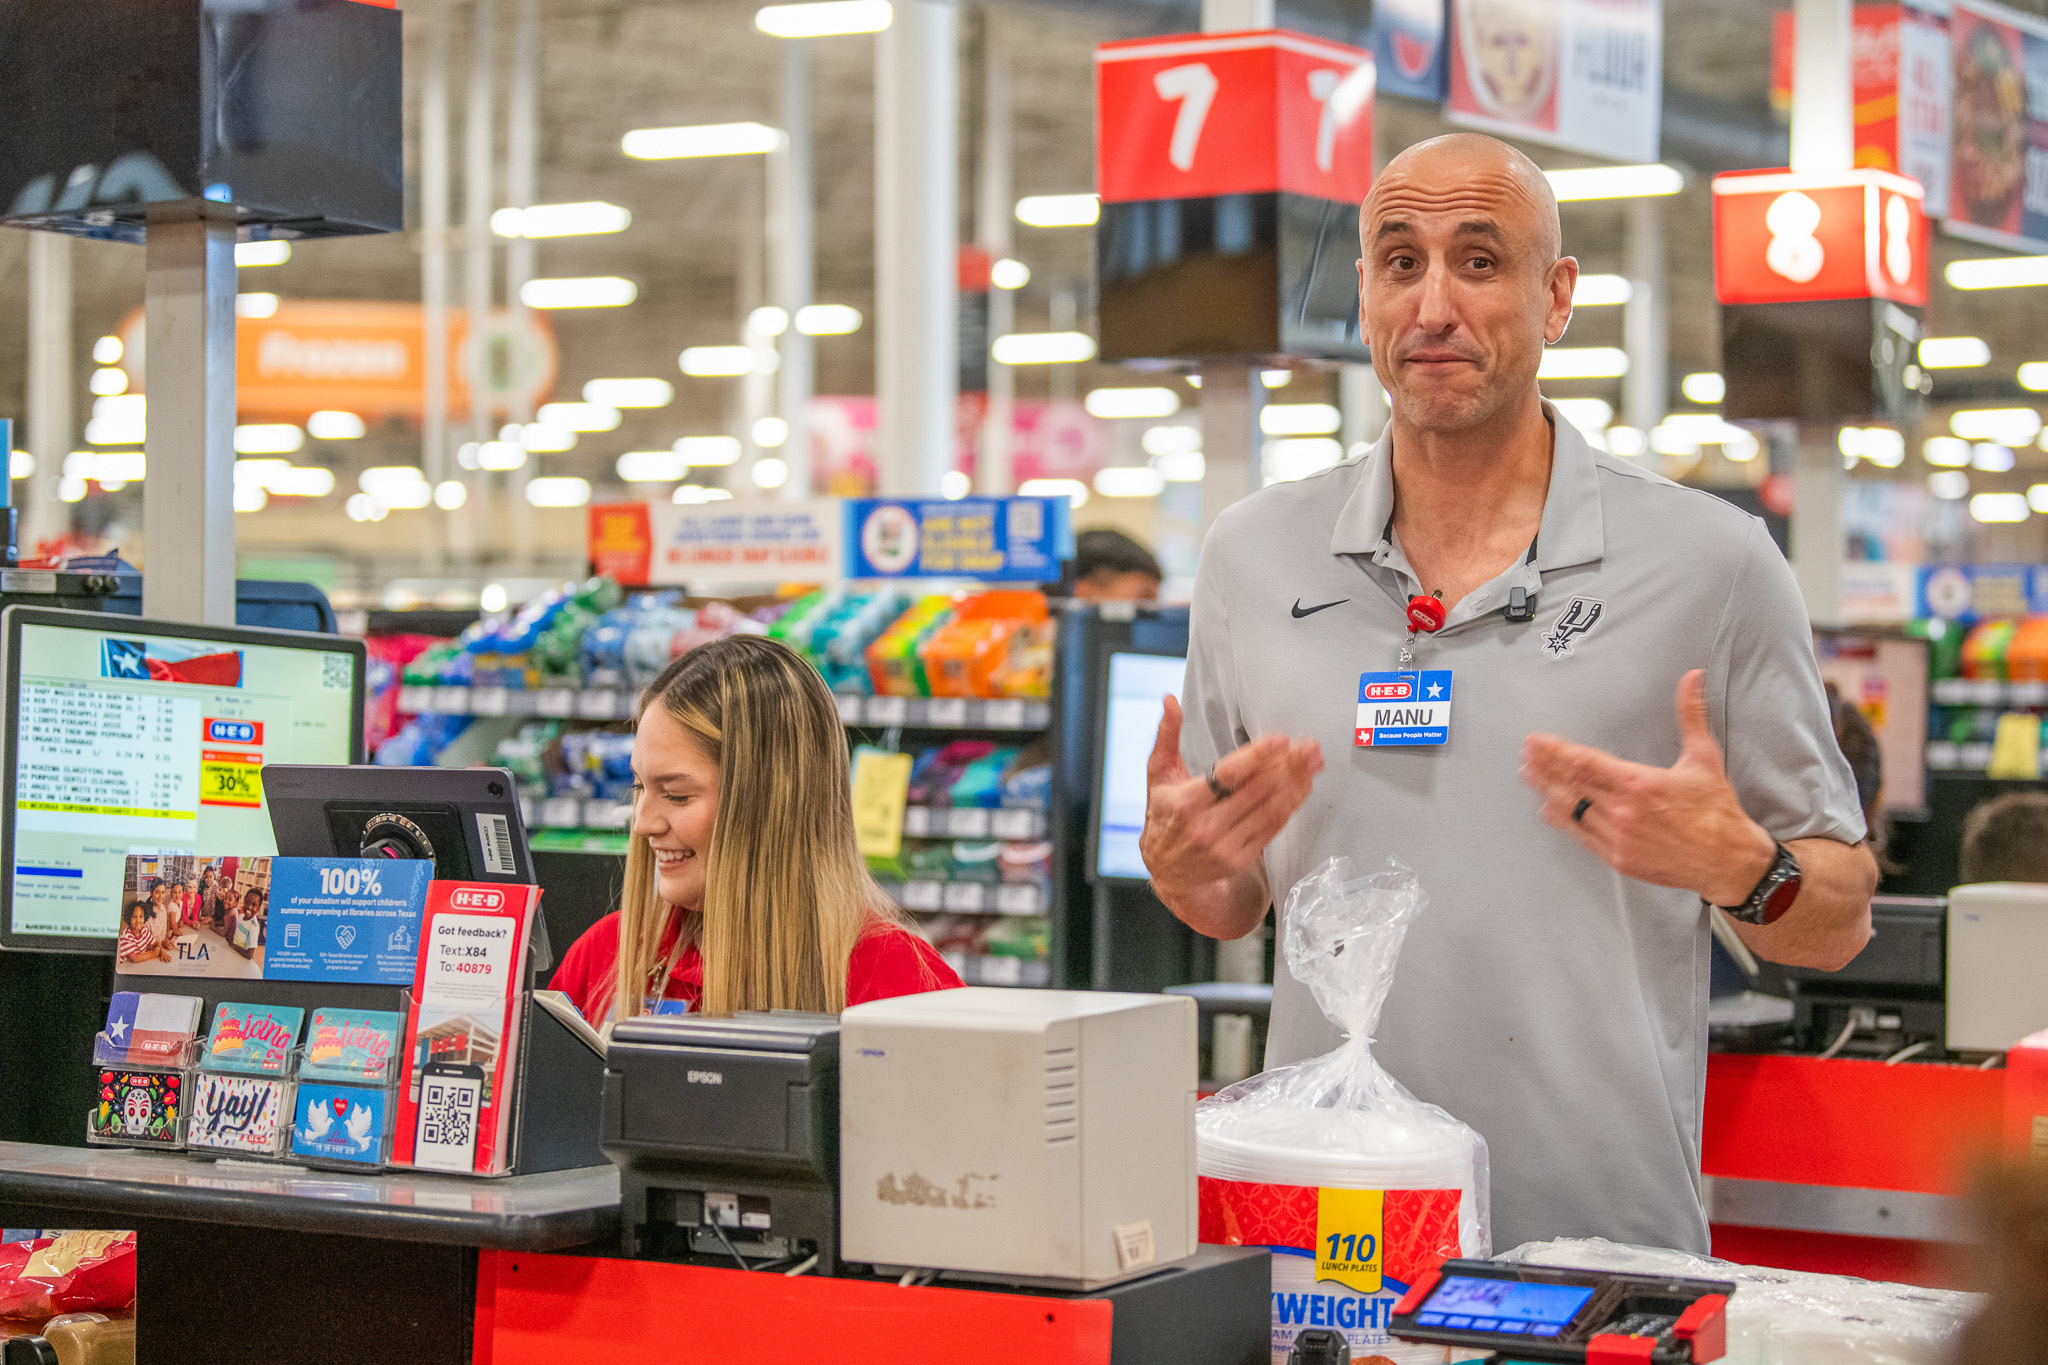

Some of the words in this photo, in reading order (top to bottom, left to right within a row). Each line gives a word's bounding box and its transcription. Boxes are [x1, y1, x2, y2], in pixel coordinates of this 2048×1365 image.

[1154, 62, 1218, 171] 7
[1766, 191, 1824, 282] 8
[1375, 709, 1433, 726] MANU
[320, 868, 382, 896] 100%
[352, 899, 376, 907] support
[306, 908, 341, 917] programing
[349, 908, 374, 917] libraries
[438, 926, 455, 935] Got
[458, 927, 507, 938] feedback?
[177, 943, 209, 960] TLA
[440, 961, 455, 972] To:
[242, 1013, 291, 1060] icing
[340, 1020, 390, 1068] icing
[687, 1070, 722, 1085] EPSON
[332, 1145, 344, 1153] THE
[1327, 1233, 1376, 1262] 110
[1322, 1261, 1348, 1271] LUNCH
[1351, 1263, 1377, 1272] PLATES
[1272, 1292, 1395, 1329] WEIGHT
[1348, 1334, 1391, 1345] PLATES
